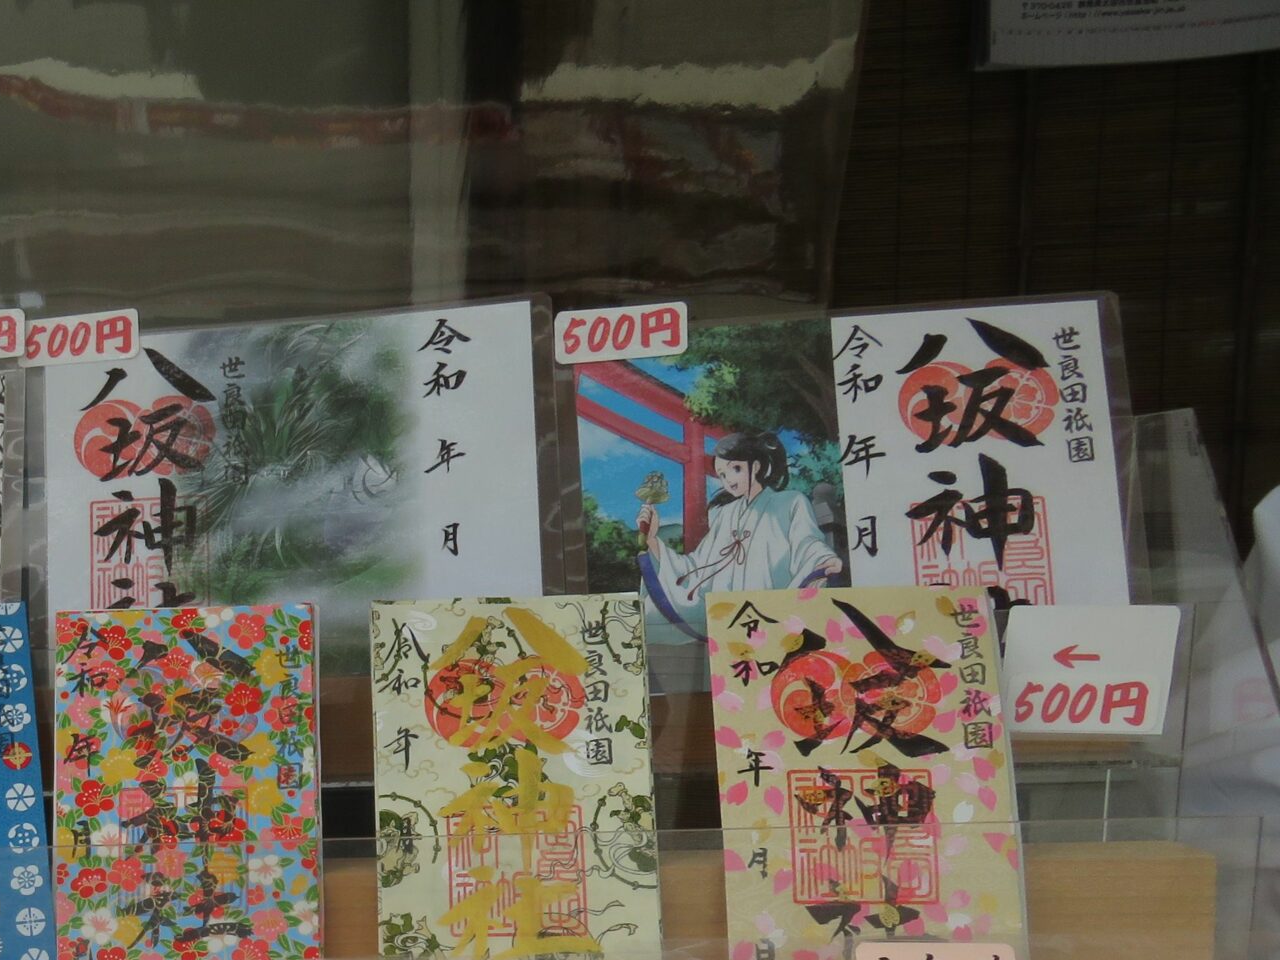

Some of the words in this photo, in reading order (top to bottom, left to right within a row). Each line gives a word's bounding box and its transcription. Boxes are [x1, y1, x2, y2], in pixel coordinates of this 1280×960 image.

[25, 315, 133, 360] 500円
[417, 318, 472, 400] 令和
[562, 309, 682, 353] 500円
[832, 324, 883, 397] 令和
[1052, 325, 1096, 463] 世良田祇園
[895, 317, 1049, 608] 八坂神
[580, 618, 614, 767] 世良田祇園
[949, 605, 995, 750] 世良田祇園
[1014, 680, 1149, 728] 500円
[119, 626, 256, 950] 八坂神社
